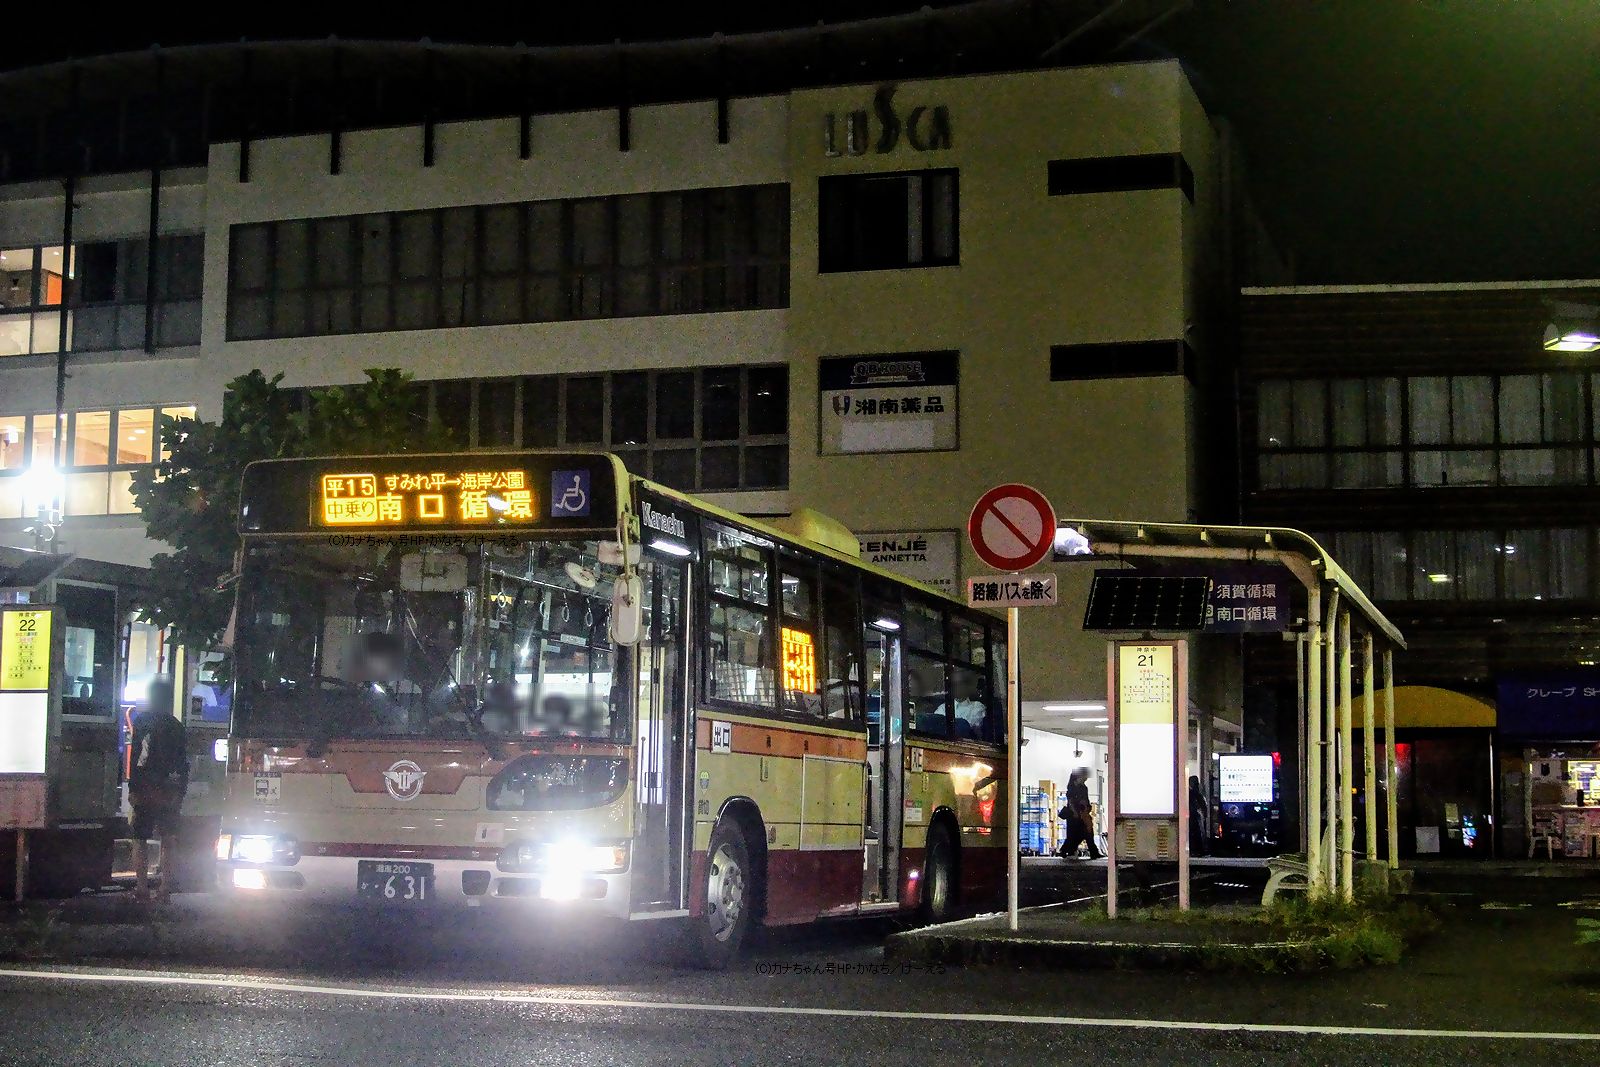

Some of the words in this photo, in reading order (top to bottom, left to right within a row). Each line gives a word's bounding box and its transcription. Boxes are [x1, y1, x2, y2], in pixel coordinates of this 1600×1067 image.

[855, 396, 945, 416] 湘南薬品
[326, 478, 375, 498] 平15
[327, 500, 376, 519] 中乗り
[377, 490, 533, 521] 南口循環
[871, 553, 927, 563] ANNETTA
[972, 580, 1052, 602] 路線バスを除く
[1216, 584, 1277, 599] 須賀循環
[1216, 606, 1278, 622] 南口循環
[19, 619, 36, 632] 22
[1137, 654, 1154, 667] 21
[1526, 686, 1577, 698] クレープ
